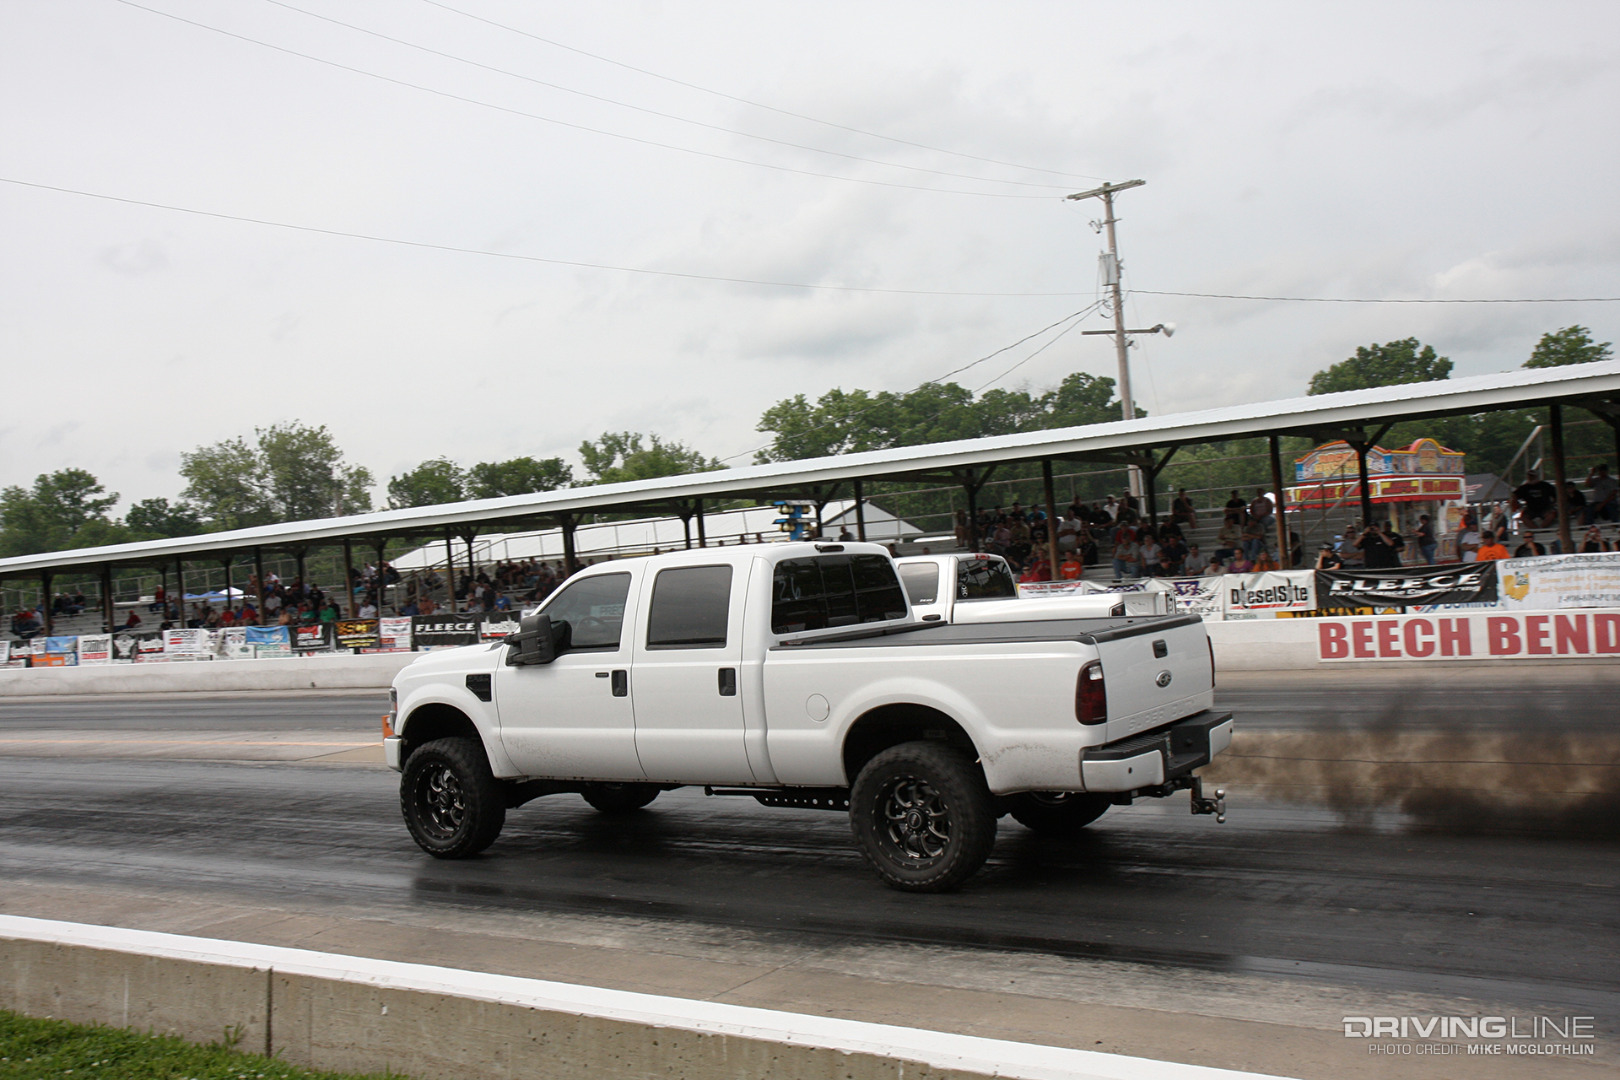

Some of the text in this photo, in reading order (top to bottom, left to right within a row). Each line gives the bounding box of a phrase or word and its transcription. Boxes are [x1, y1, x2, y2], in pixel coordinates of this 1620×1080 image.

[779, 575, 801, 600] 26
[1231, 577, 1308, 608] DieselSite
[1329, 573, 1482, 591] FLEECE
[1329, 587, 1406, 597] Performance
[414, 622, 476, 632] FLEECE
[1318, 613, 1620, 659] BEECH BEND
